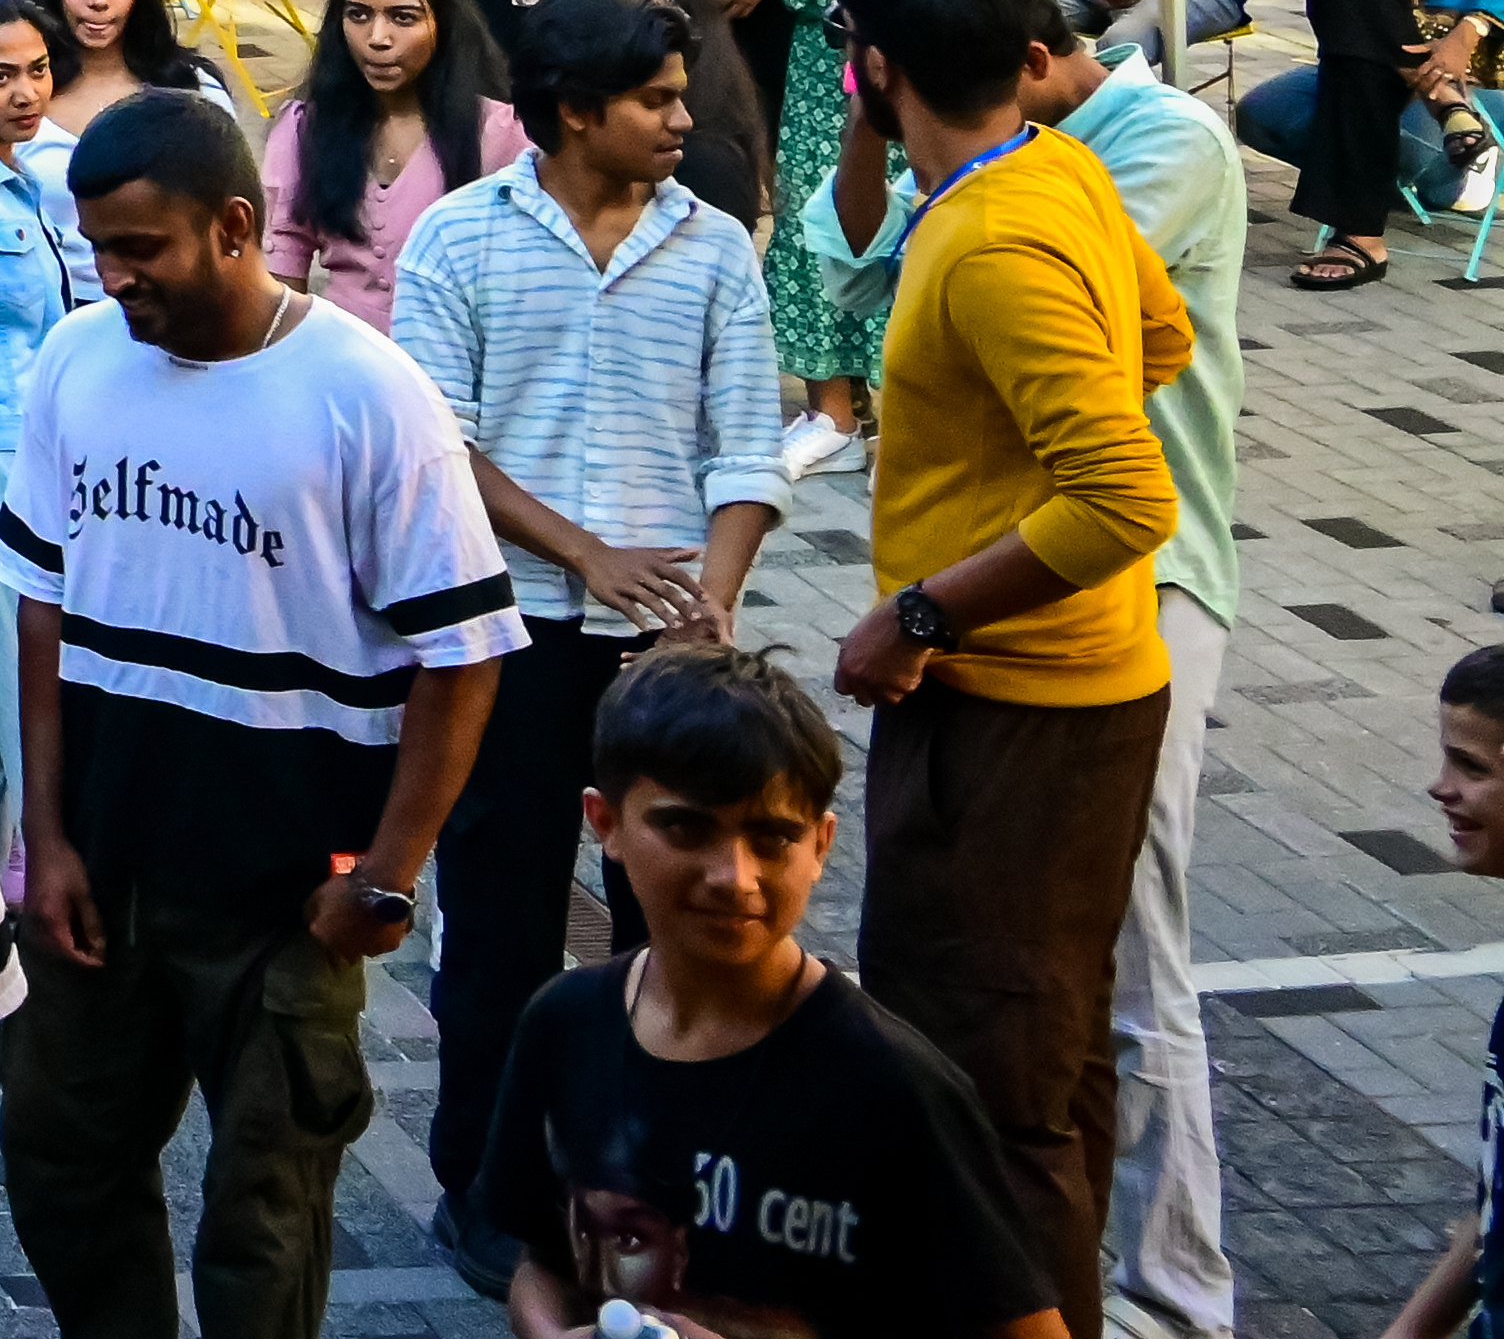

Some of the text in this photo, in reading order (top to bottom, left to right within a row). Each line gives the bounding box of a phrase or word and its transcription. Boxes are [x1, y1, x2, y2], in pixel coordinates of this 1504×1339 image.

[69, 454, 286, 569] Selfmade
[694, 1151, 861, 1264] 50 cent
